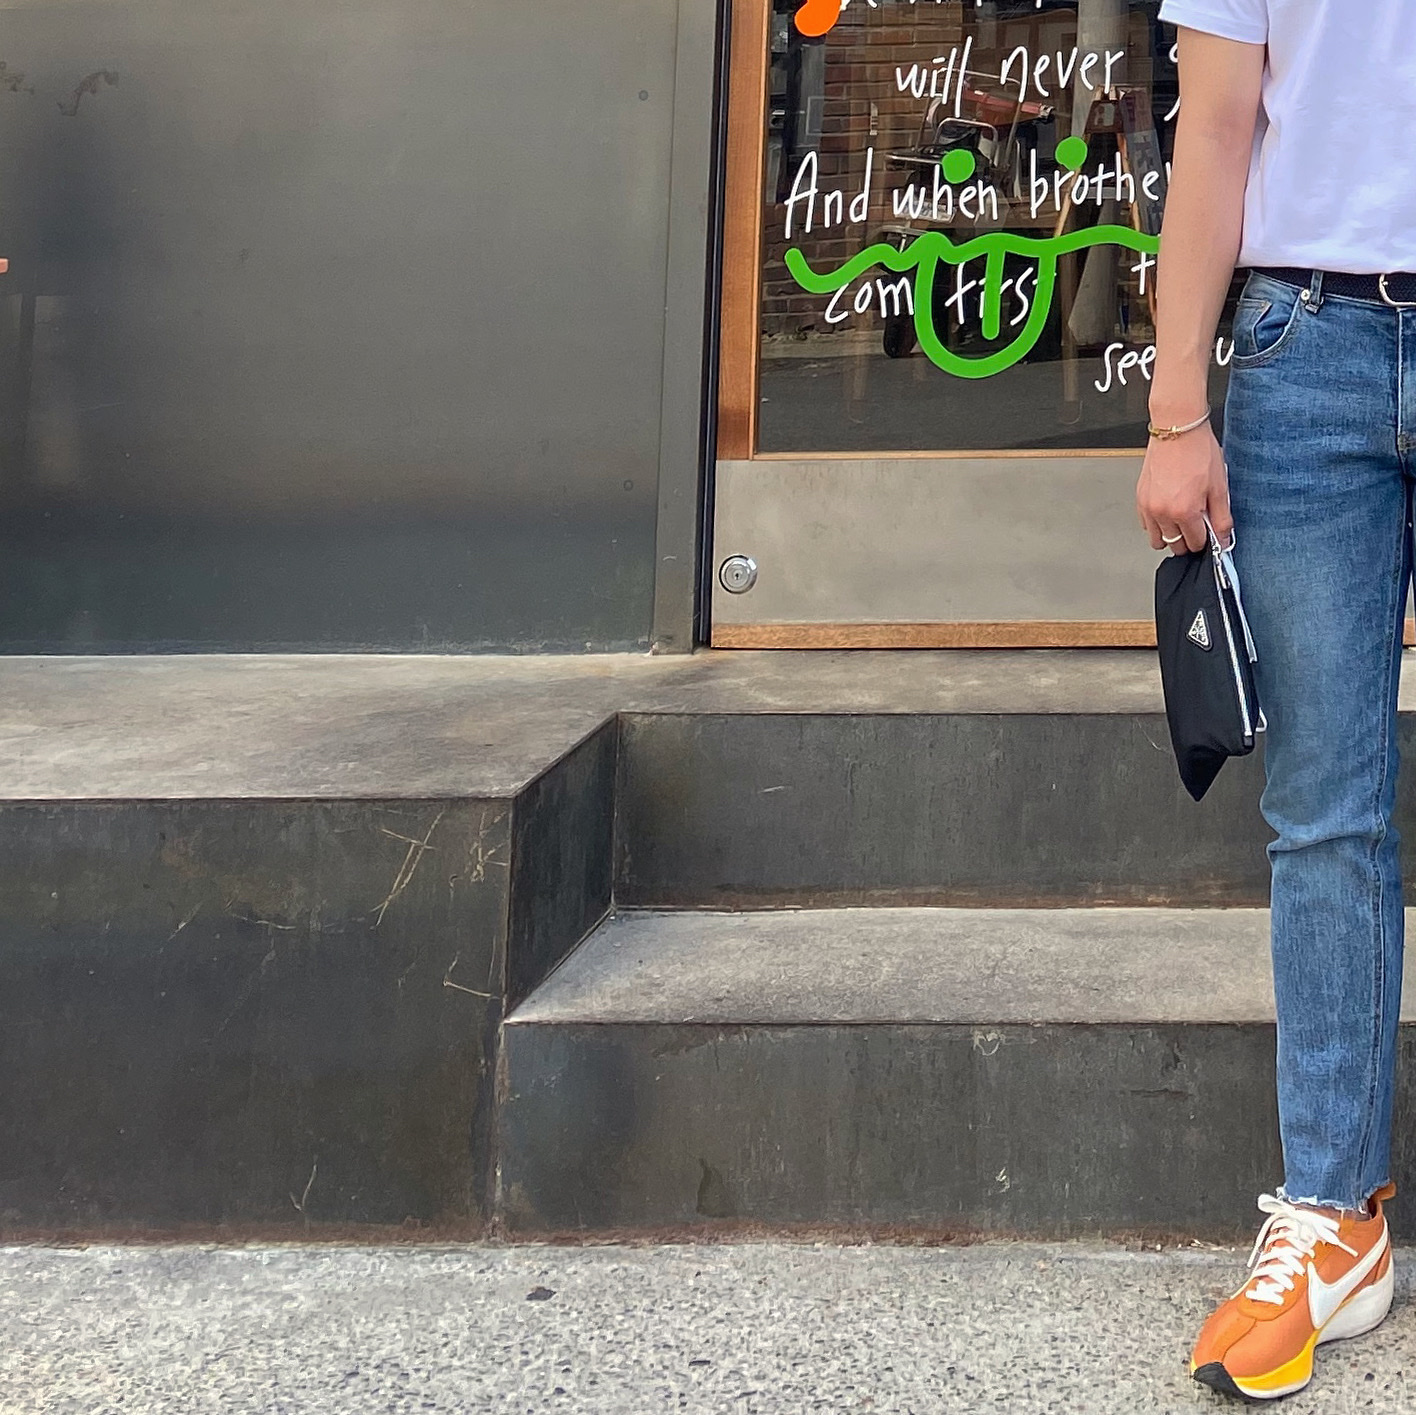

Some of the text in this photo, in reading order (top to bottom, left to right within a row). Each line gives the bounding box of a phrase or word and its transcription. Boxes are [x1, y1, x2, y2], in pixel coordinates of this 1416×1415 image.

[895, 35, 973, 118] will
[1000, 45, 1125, 103] never
[784, 147, 873, 239] And
[892, 163, 998, 220] when
